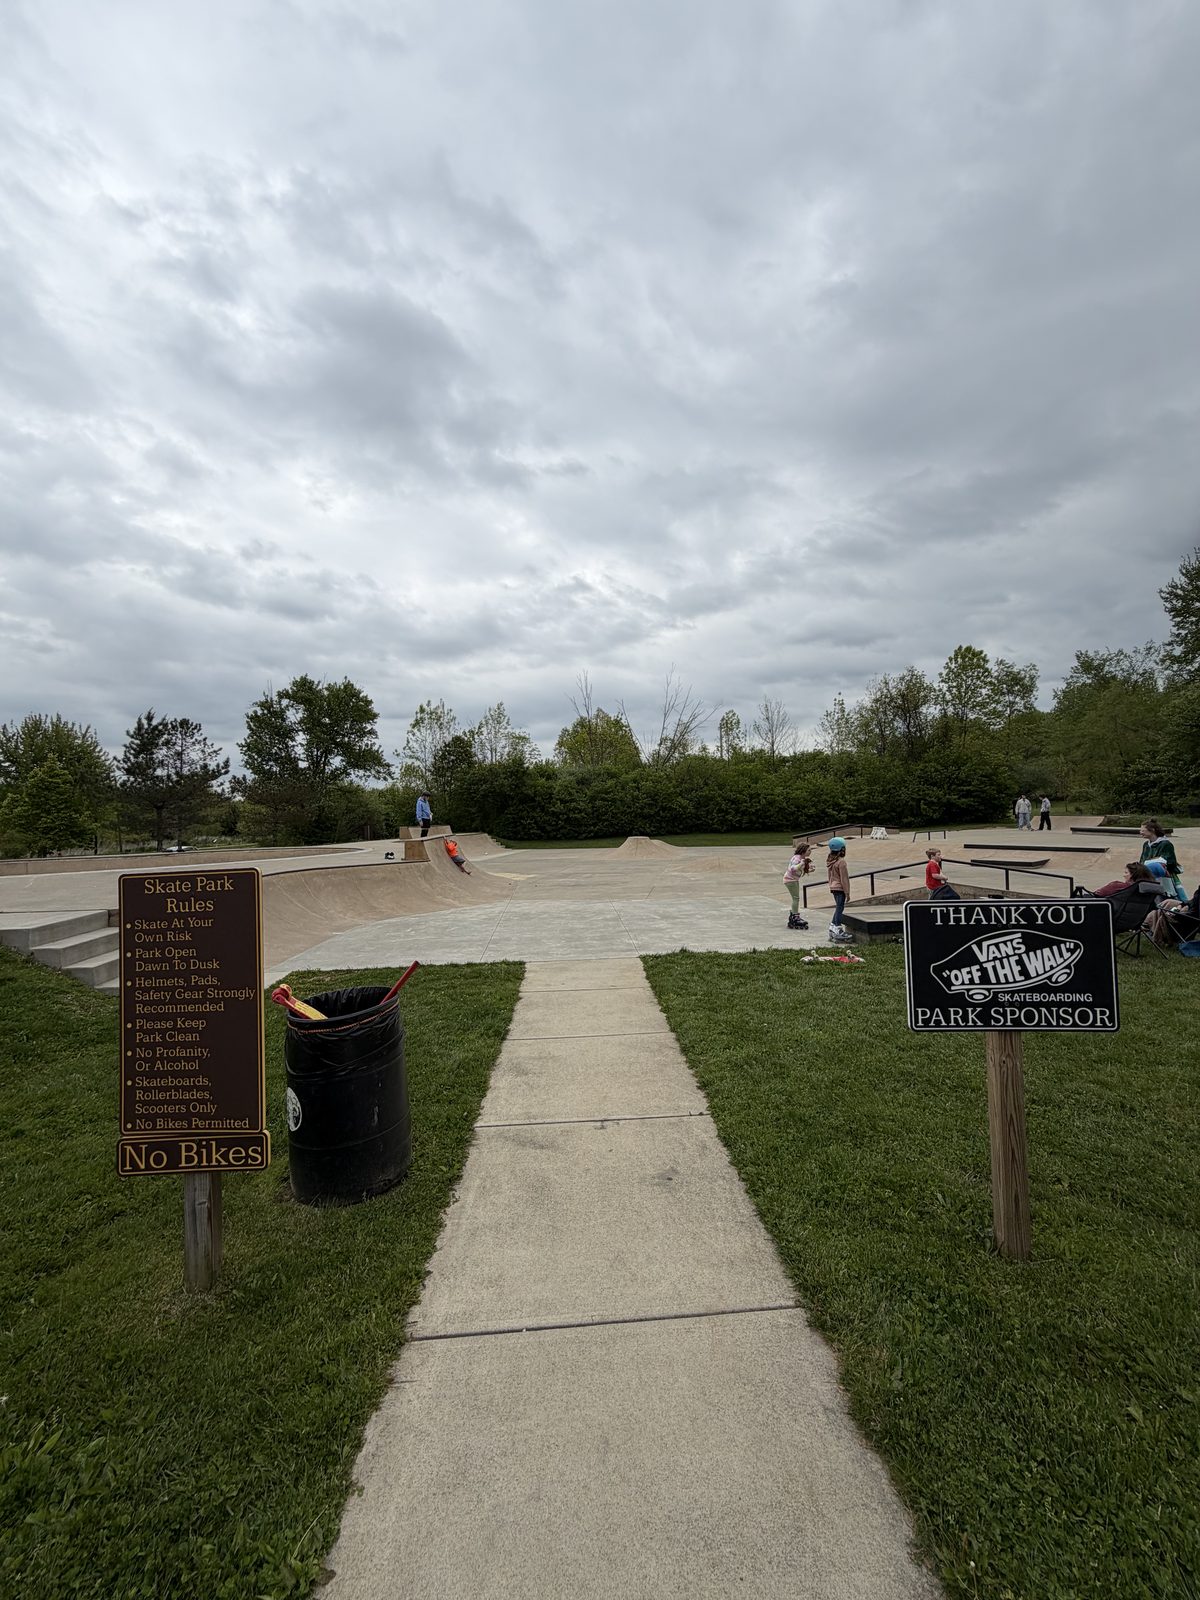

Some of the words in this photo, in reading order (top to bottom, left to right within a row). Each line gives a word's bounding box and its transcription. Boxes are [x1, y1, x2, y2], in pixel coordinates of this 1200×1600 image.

[144, 879, 192, 894] Skate
[196, 876, 234, 892] Park
[166, 898, 214, 913] Rules
[930, 907, 1027, 925] THANK
[1033, 906, 1086, 925] YOU
[135, 919, 168, 930] Skate
[171, 918, 184, 928] At
[188, 917, 214, 927] Your
[135, 932, 163, 943] Own
[167, 931, 192, 941] Risk
[135, 948, 162, 959] Park
[165, 947, 197, 959] Open
[971, 932, 1026, 963] VANS
[135, 961, 170, 972] Dawn
[172, 960, 187, 970] To
[190, 959, 220, 969] Dusk
[983, 955, 1025, 984] THE
[135, 977, 187, 988] Helmets,
[191, 975, 221, 986] Pads,
[135, 990, 172, 1002] Safety
[175, 989, 204, 999] Gear
[207, 987, 256, 1000] Strongly
[998, 993, 1093, 1002] SKATEBOARDING
[135, 1001, 225, 1014] Recommended
[916, 1008, 983, 1027] PARK
[991, 1007, 1113, 1027] SPONSOR
[135, 1019, 174, 1029] Please
[177, 1018, 207, 1030] Keep
[135, 1032, 162, 1043] Park
[165, 1031, 200, 1042] Clean
[135, 1048, 153, 1058] No
[156, 1046, 211, 1059] Profanity,
[135, 1061, 151, 1071] Or
[154, 1060, 199, 1071] Alcohol
[135, 1075, 212, 1087] Skateboards,
[135, 1089, 213, 1100] Rollerblades,
[135, 1102, 187, 1114] Scooters
[190, 1102, 217, 1115] Only
[135, 1119, 153, 1129] No
[156, 1118, 188, 1129] Bikes
[191, 1117, 249, 1129] Permitted
[123, 1144, 168, 1170] No
[178, 1141, 262, 1167] Bikes
